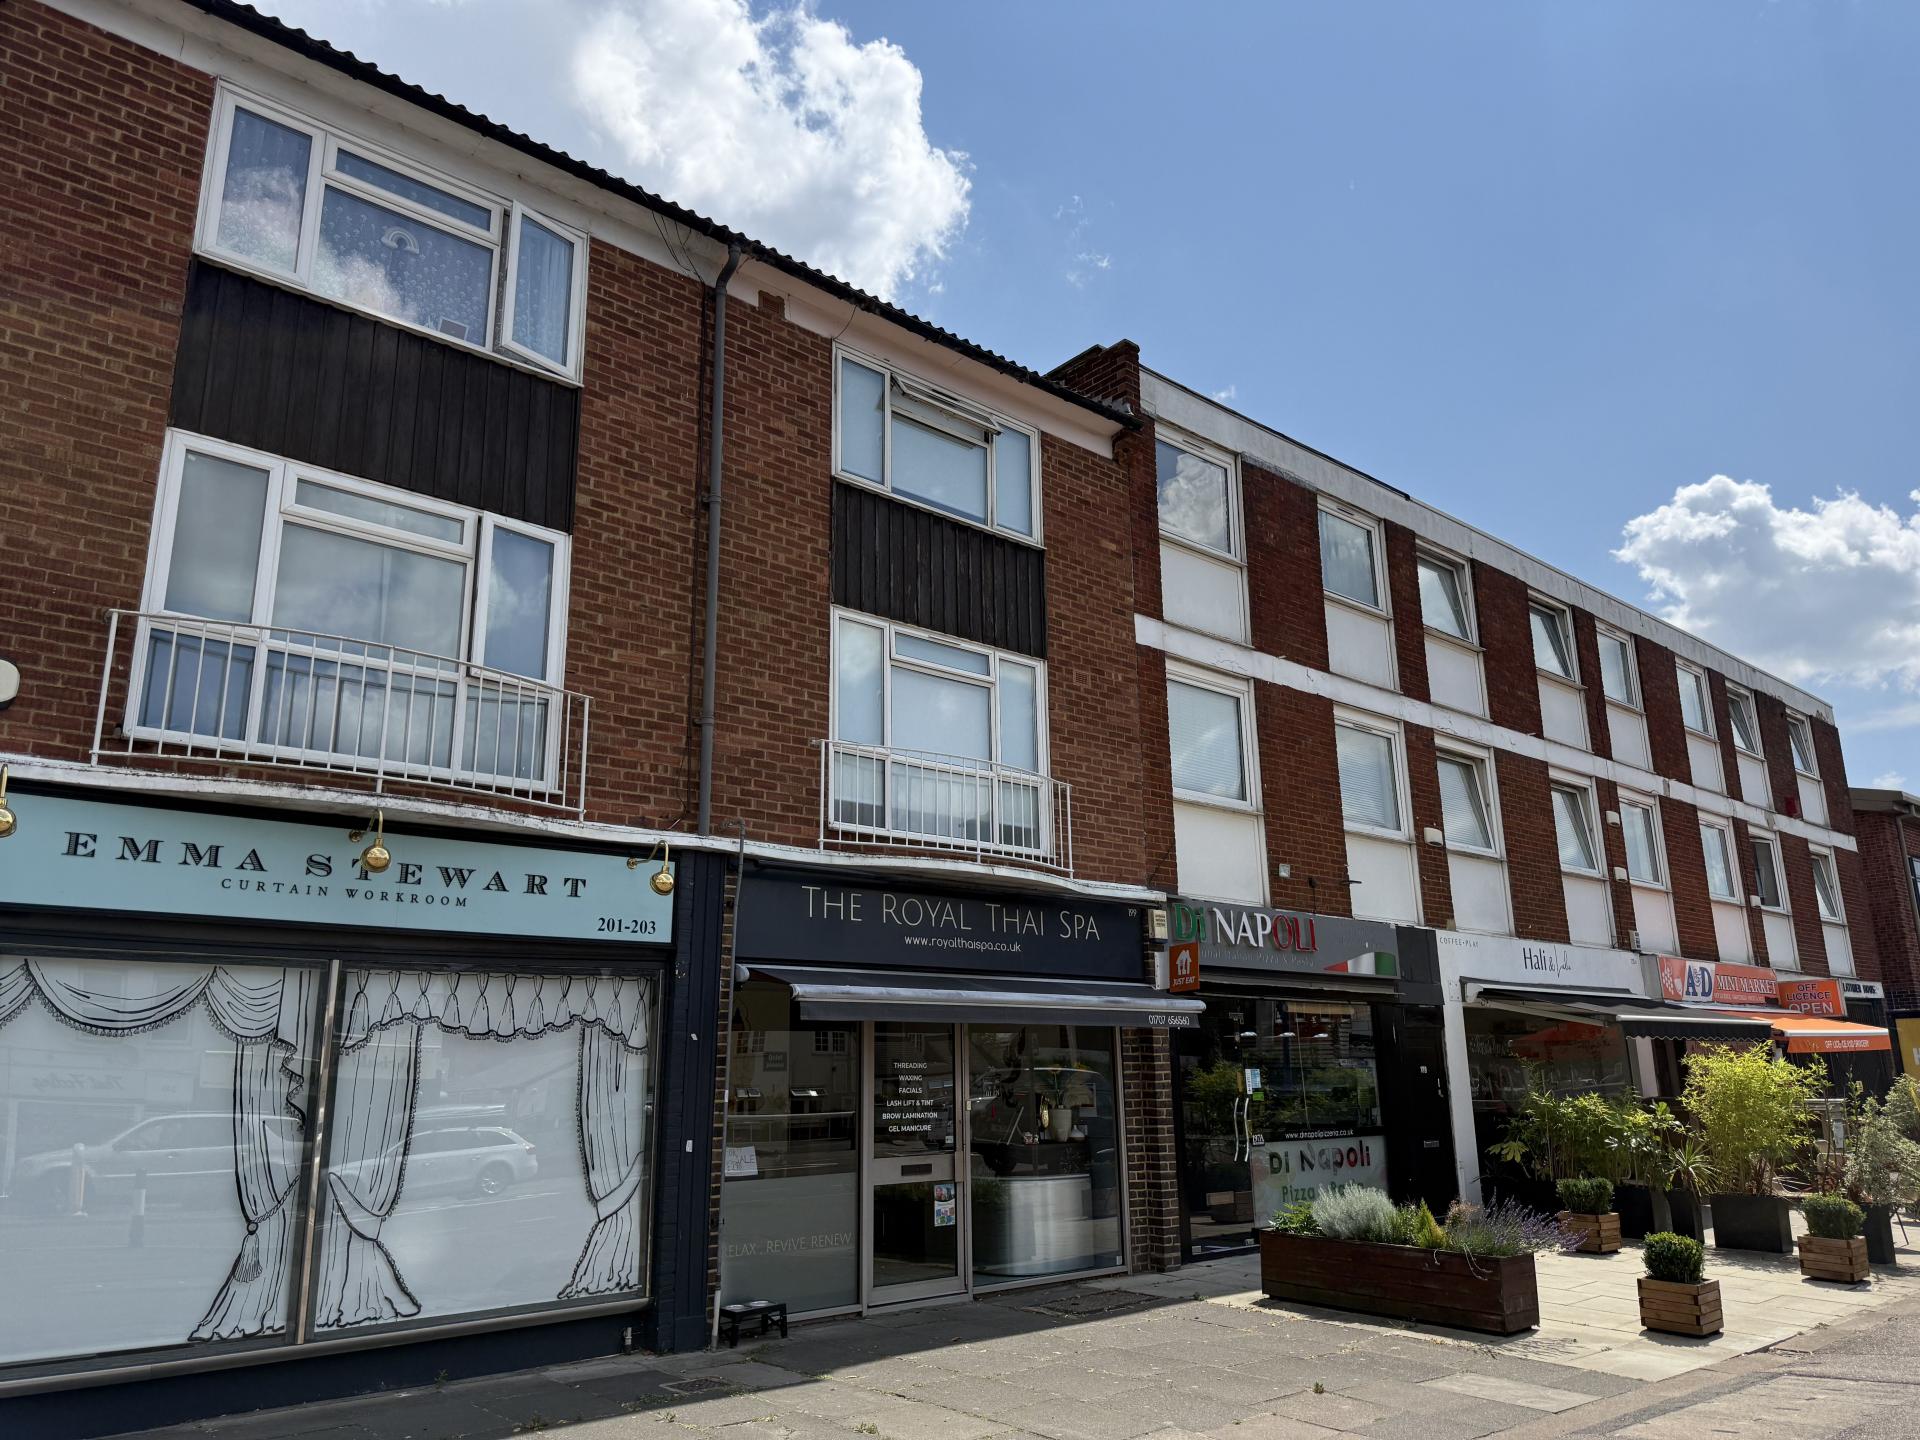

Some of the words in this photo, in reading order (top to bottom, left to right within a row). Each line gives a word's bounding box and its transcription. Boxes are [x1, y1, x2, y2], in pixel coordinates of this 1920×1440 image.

[61, 831, 267, 872] EMMA
[304, 852, 587, 899] STEWART
[220, 878, 329, 898] CURTAIN
[345, 888, 469, 908] WORKROOM
[801, 885, 862, 922] THE
[882, 893, 972, 932] ROYAL
[985, 902, 1045, 937] THAI
[1059, 911, 1101, 942] SPA
[596, 917, 657, 935] 201-203
[1174, 903, 1207, 943] Di
[1212, 907, 1319, 952] NAPOLI
[904, 934, 1022, 953] www.royalthaispa.co.uk
[1523, 947, 1547, 971] Hali
[1172, 978, 1185, 987] JUST
[1185, 975, 1196, 984] EAT
[1716, 974, 1739, 992] MINI
[1740, 977, 1777, 994] MARKET
[1797, 983, 1817, 991] OFF
[1786, 991, 1831, 1001] LICENCE
[1788, 1001, 1834, 1014] OPEN
[882, 1112, 901, 1120] BROW
[901, 1124, 932, 1132] MANICURE
[1299, 1139, 1371, 1176] Napoli
[1282, 1184, 1315, 1202] Pizza
[766, 1236, 806, 1253] REVIVE
[811, 1231, 852, 1249] RENEW
